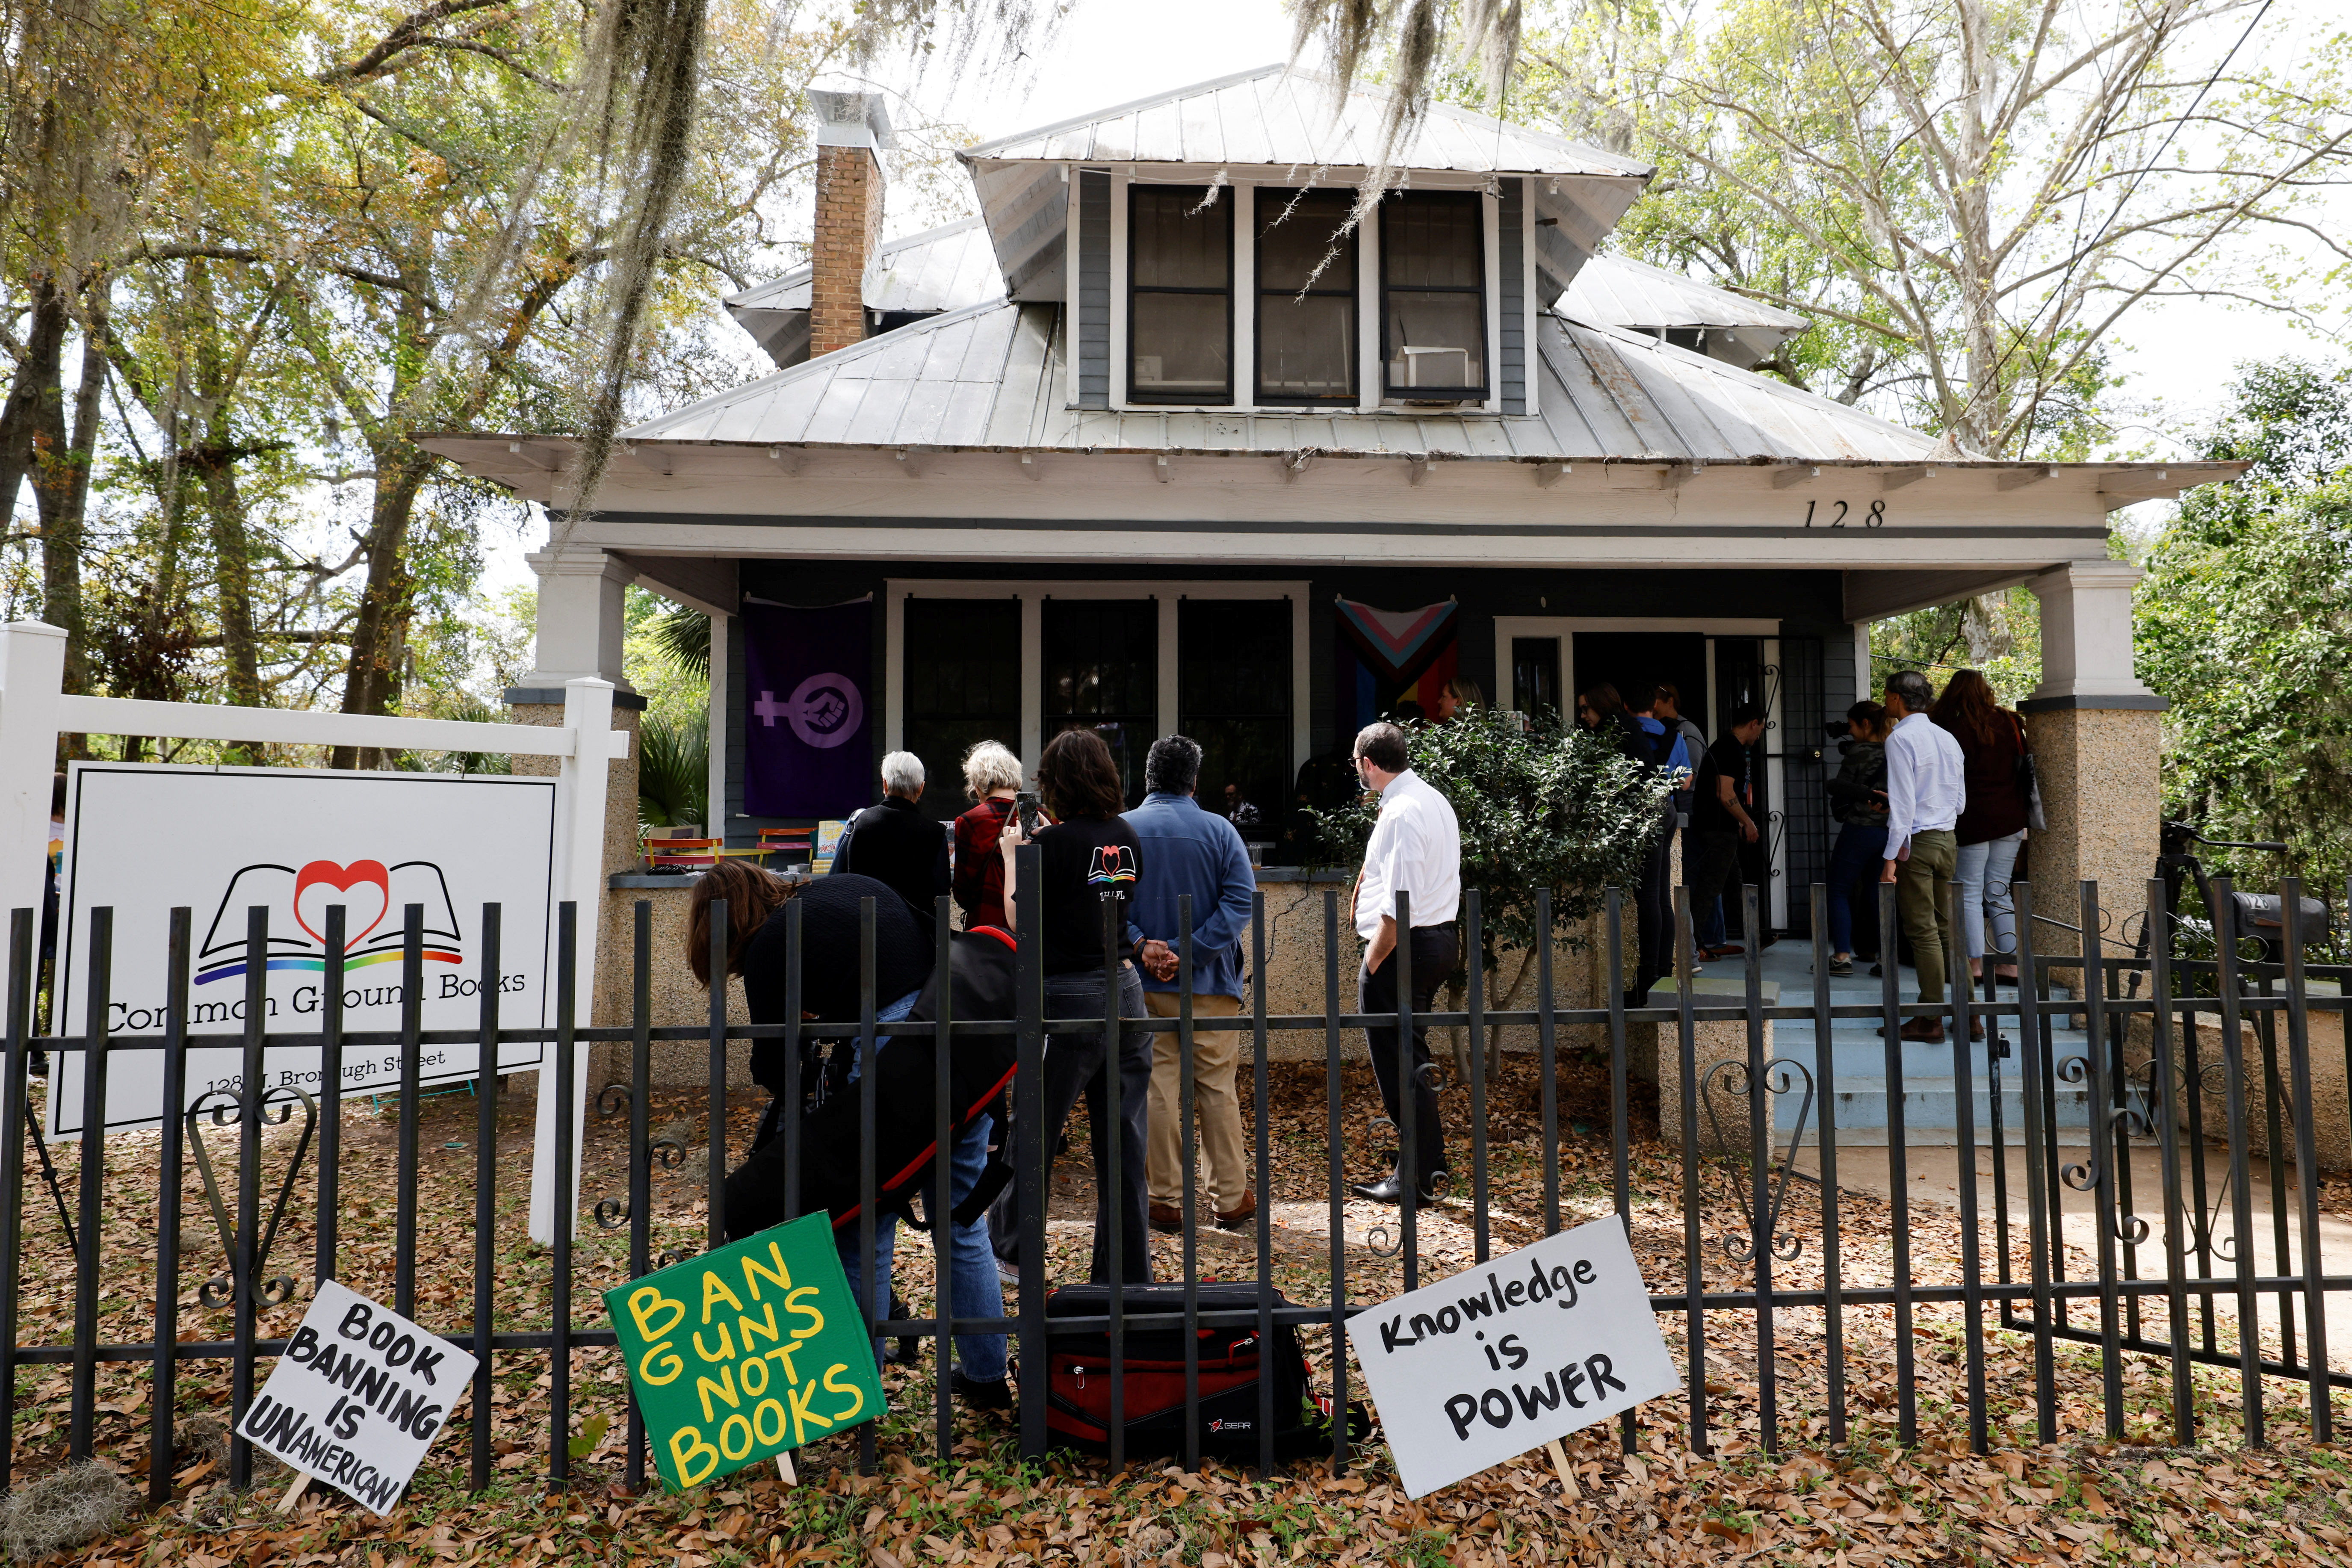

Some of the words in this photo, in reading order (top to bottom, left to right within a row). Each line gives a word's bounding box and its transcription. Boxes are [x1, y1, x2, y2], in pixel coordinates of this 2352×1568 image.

[1805, 500, 1886, 529] 128
[1116, 890, 1125, 900] FL
[2243, 895, 2269, 909] 128
[293, 977, 426, 1013] Goun
[438, 970, 525, 999] Boks
[207, 1075, 243, 1096] 128
[279, 1060, 377, 1087] Brough
[384, 1050, 446, 1072] Steet
[627, 1241, 791, 1342] BAN
[1380, 1257, 1597, 1354] Knowledge
[337, 1303, 445, 1386] BOOK
[639, 1286, 824, 1385] GUNS
[1474, 1330, 1528, 1371] is
[285, 1326, 442, 1441] BANNING
[324, 1395, 366, 1440] IS
[696, 1340, 803, 1423] NOT
[1444, 1353, 1626, 1441] POWER
[245, 1395, 400, 1510] UNAMERICAN
[669, 1363, 863, 1488] BOOKS
